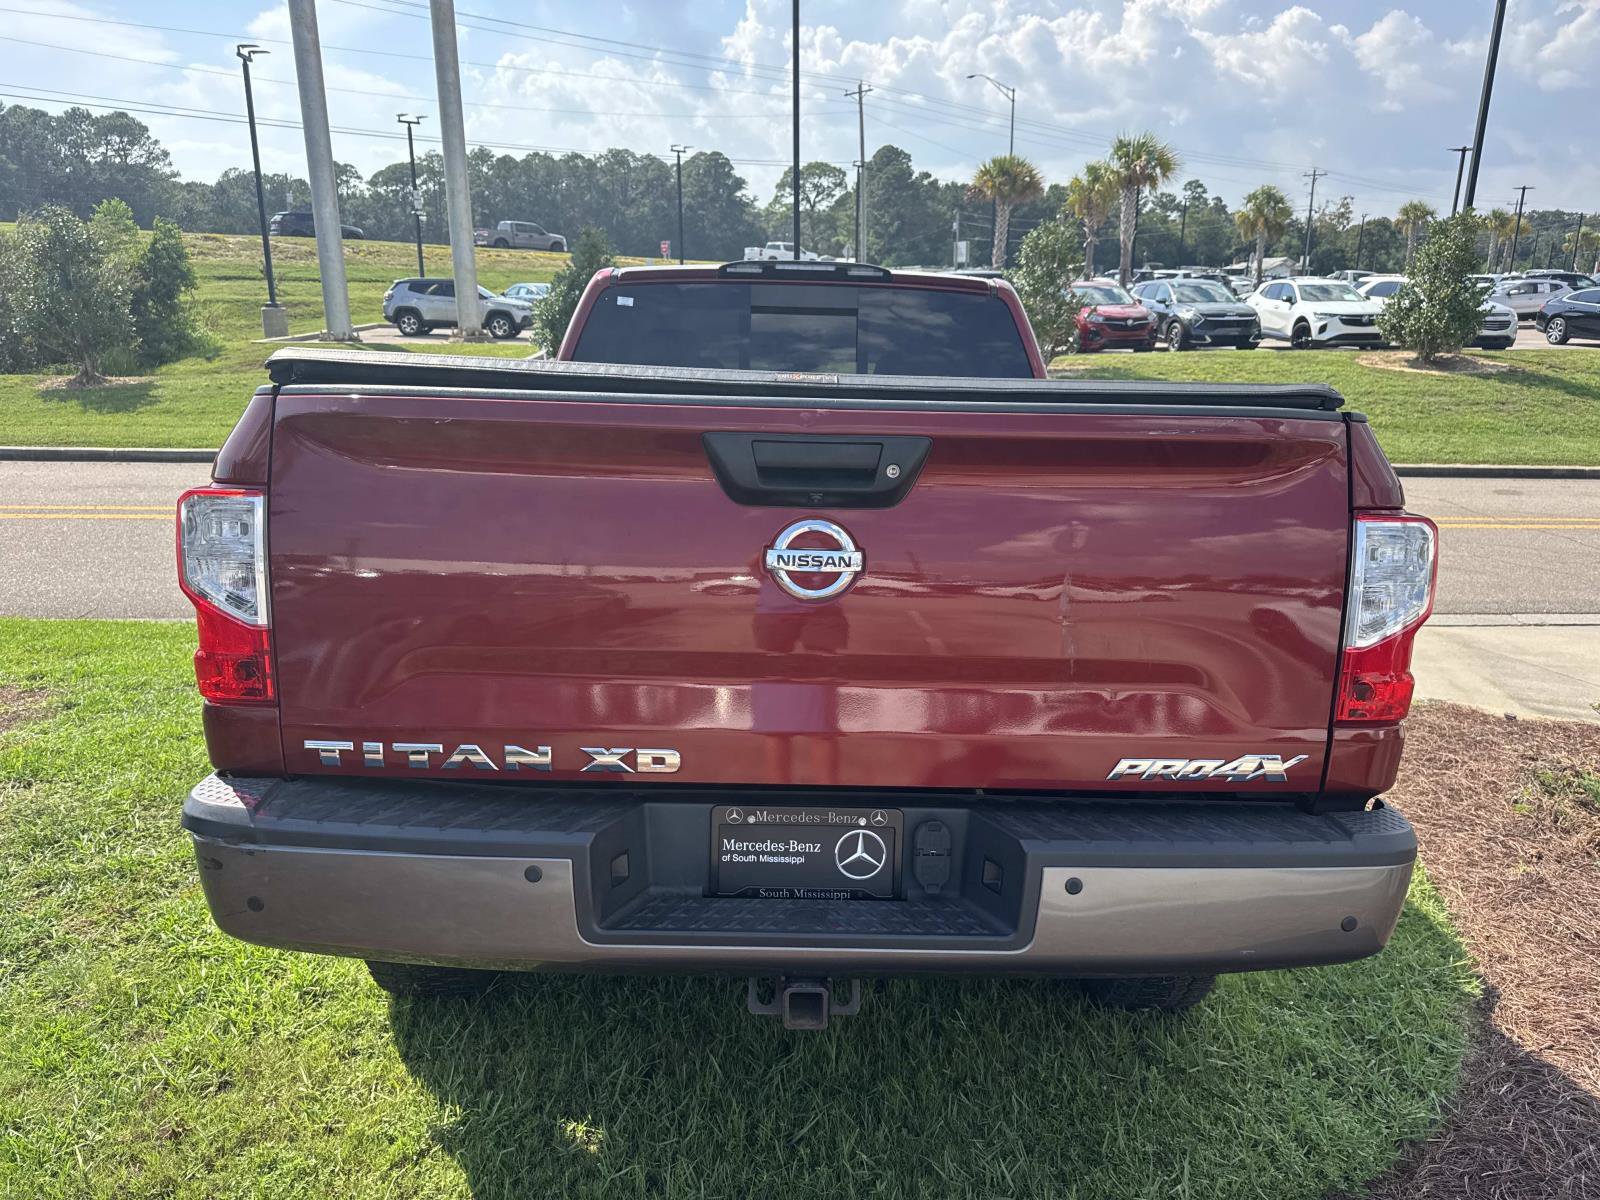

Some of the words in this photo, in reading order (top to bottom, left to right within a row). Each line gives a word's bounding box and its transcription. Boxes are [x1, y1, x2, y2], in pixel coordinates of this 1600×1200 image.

[776, 554, 852, 568] NISSAN
[303, 739, 553, 771] TITAN
[579, 747, 681, 774] XD
[756, 809, 858, 824] Mercedes-Benz
[722, 838, 821, 853] Mercedes-Benz
[721, 854, 730, 862] of
[732, 854, 757, 863] South
[759, 855, 805, 865] Mississippi
[759, 889, 790, 898] South
[793, 889, 851, 901] Mississippi
